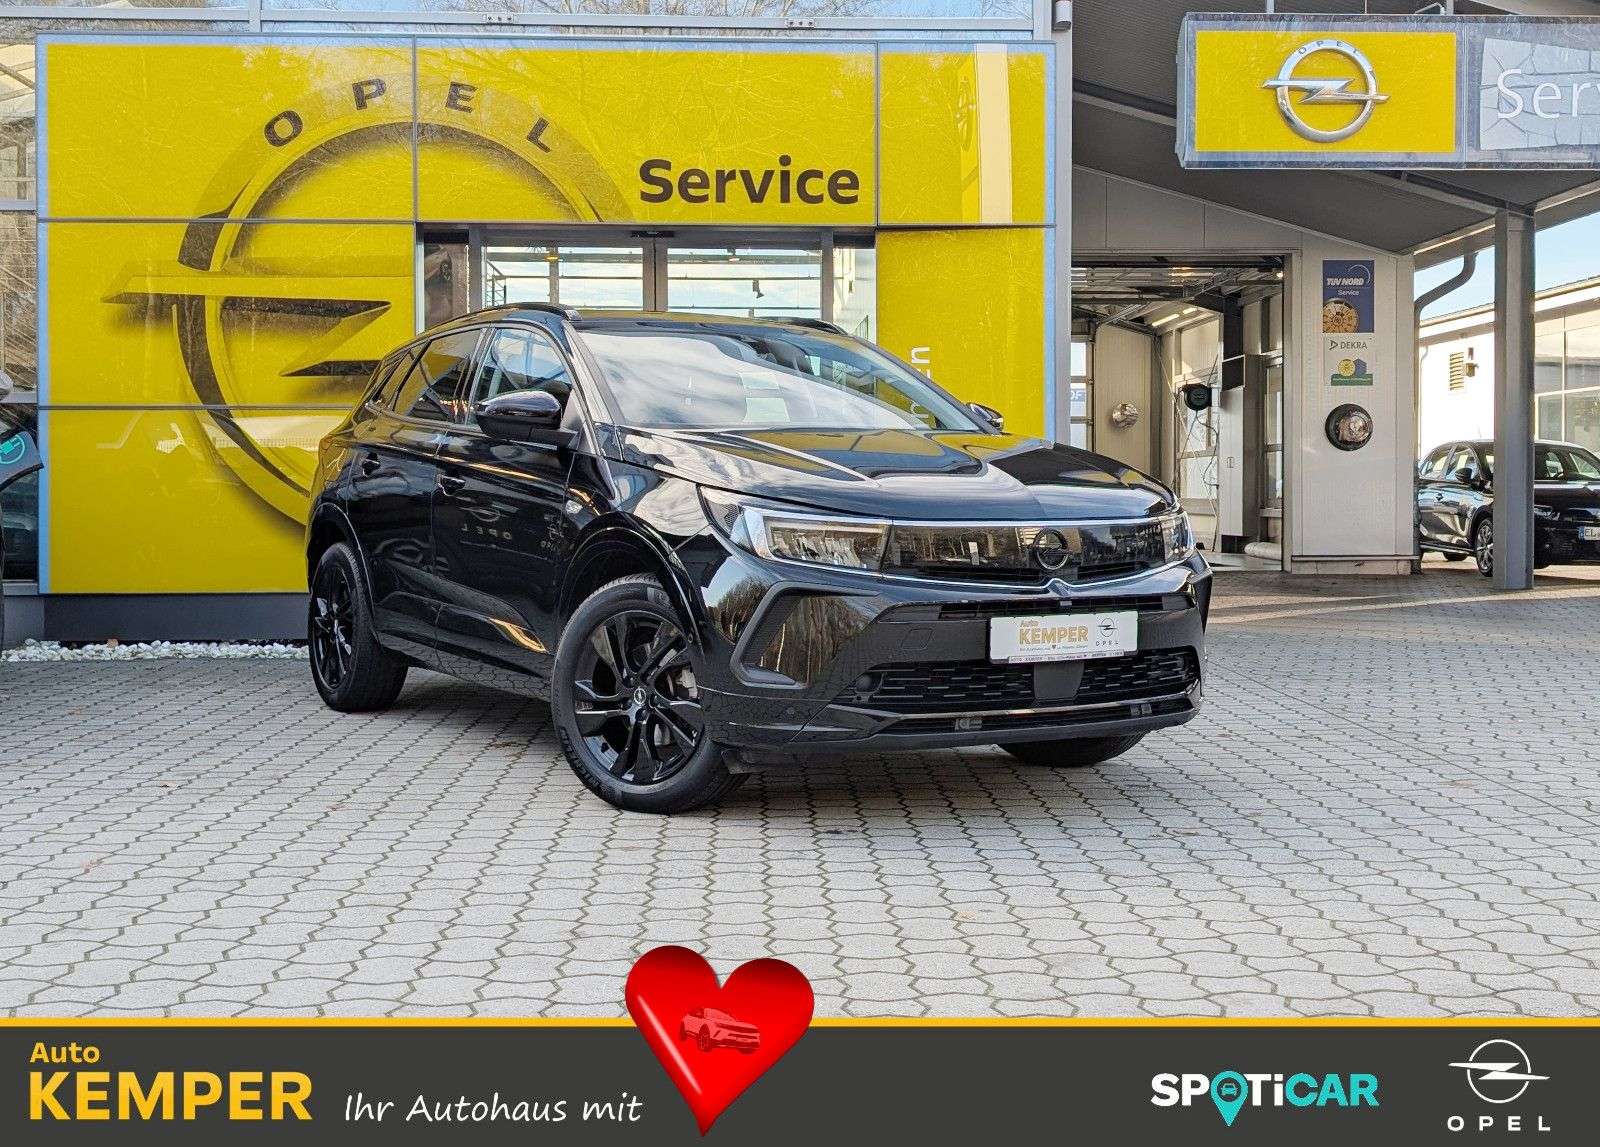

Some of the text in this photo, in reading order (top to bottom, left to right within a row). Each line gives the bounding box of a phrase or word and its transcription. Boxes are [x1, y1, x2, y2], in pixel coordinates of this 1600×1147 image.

[1298, 40, 1360, 55] OPEL
[1497, 68, 1600, 119] Ser
[264, 78, 551, 153] OPEL
[639, 154, 860, 205] Service
[1341, 277, 1364, 286] NORD
[1340, 341, 1368, 349] DEKRA
[1019, 626, 1089, 645] KEMPER
